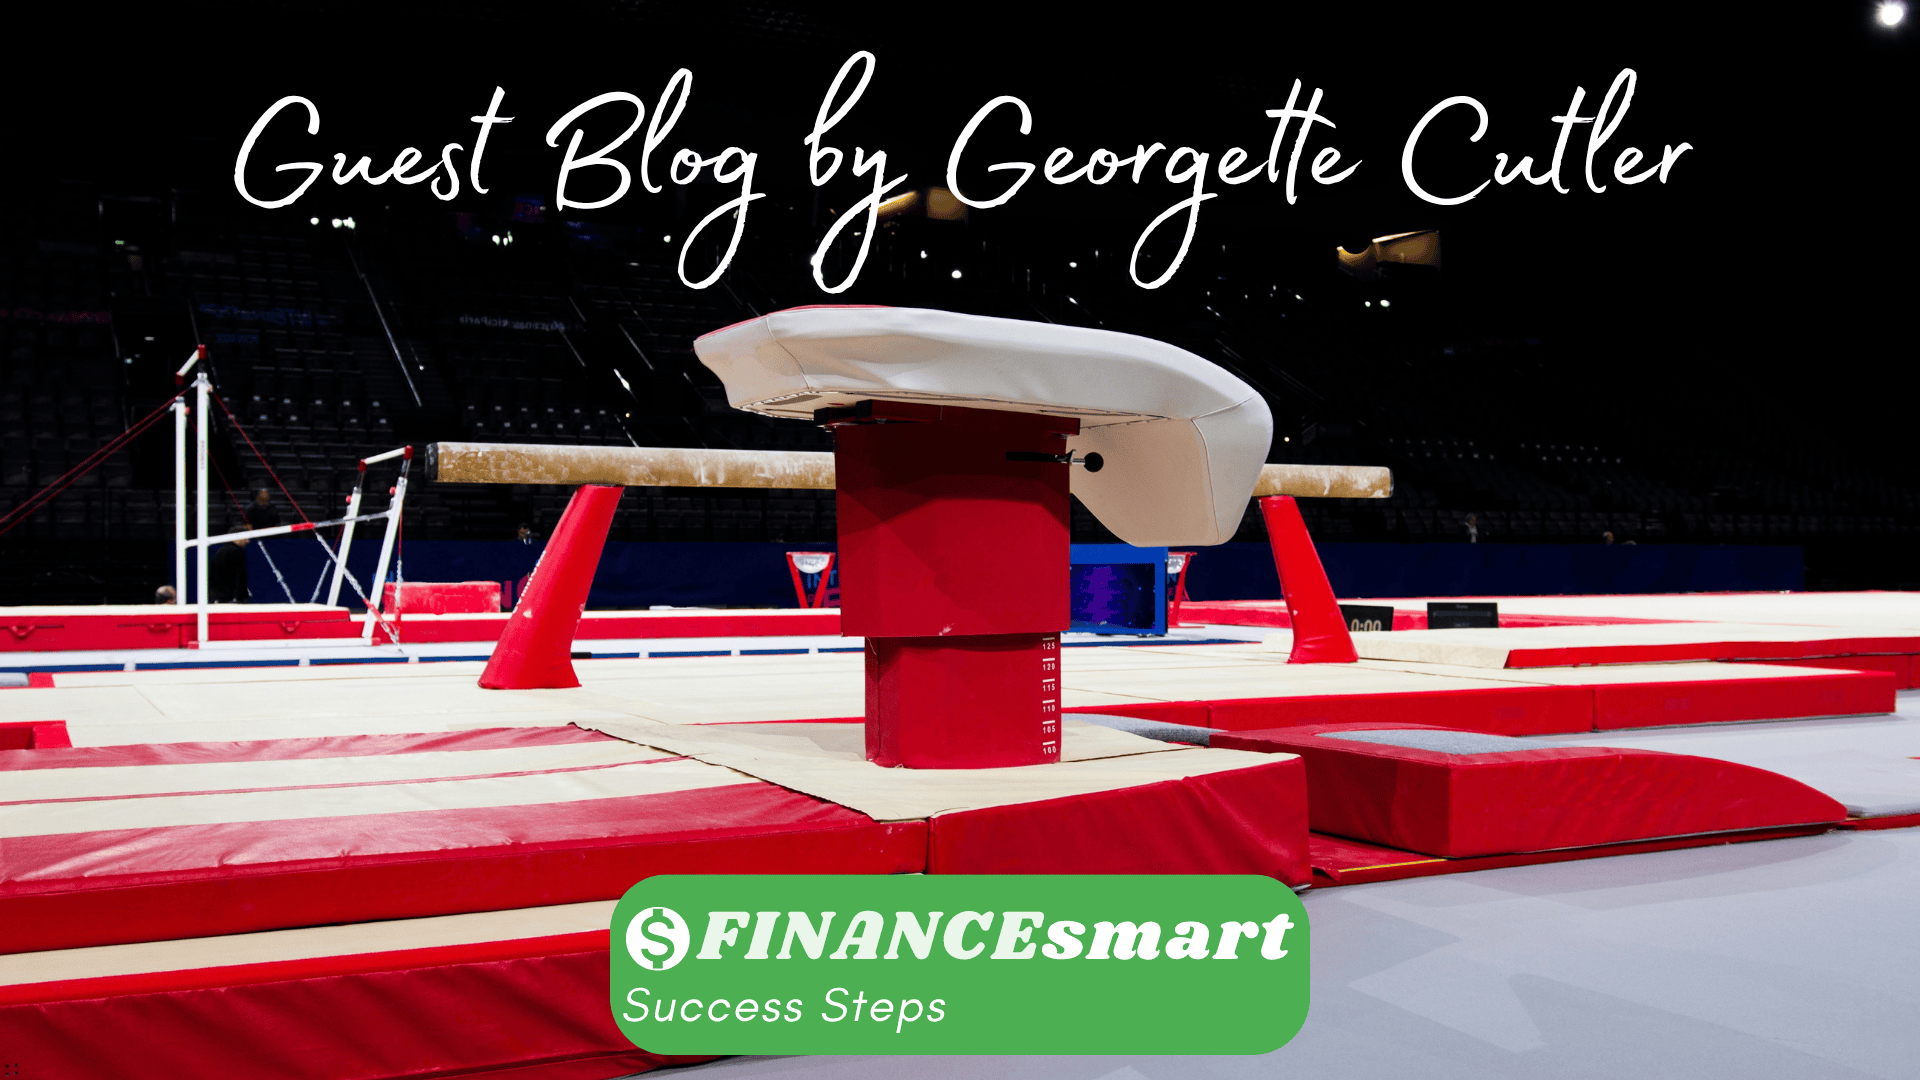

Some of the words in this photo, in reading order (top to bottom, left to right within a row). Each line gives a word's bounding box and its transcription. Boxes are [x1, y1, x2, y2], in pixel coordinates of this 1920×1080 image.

[1042, 642, 1056, 650] 125
[1042, 663, 1056, 671] 120
[1042, 704, 1056, 713] 110
[1042, 725, 1056, 734] 105
[1042, 746, 1057, 755] 100
